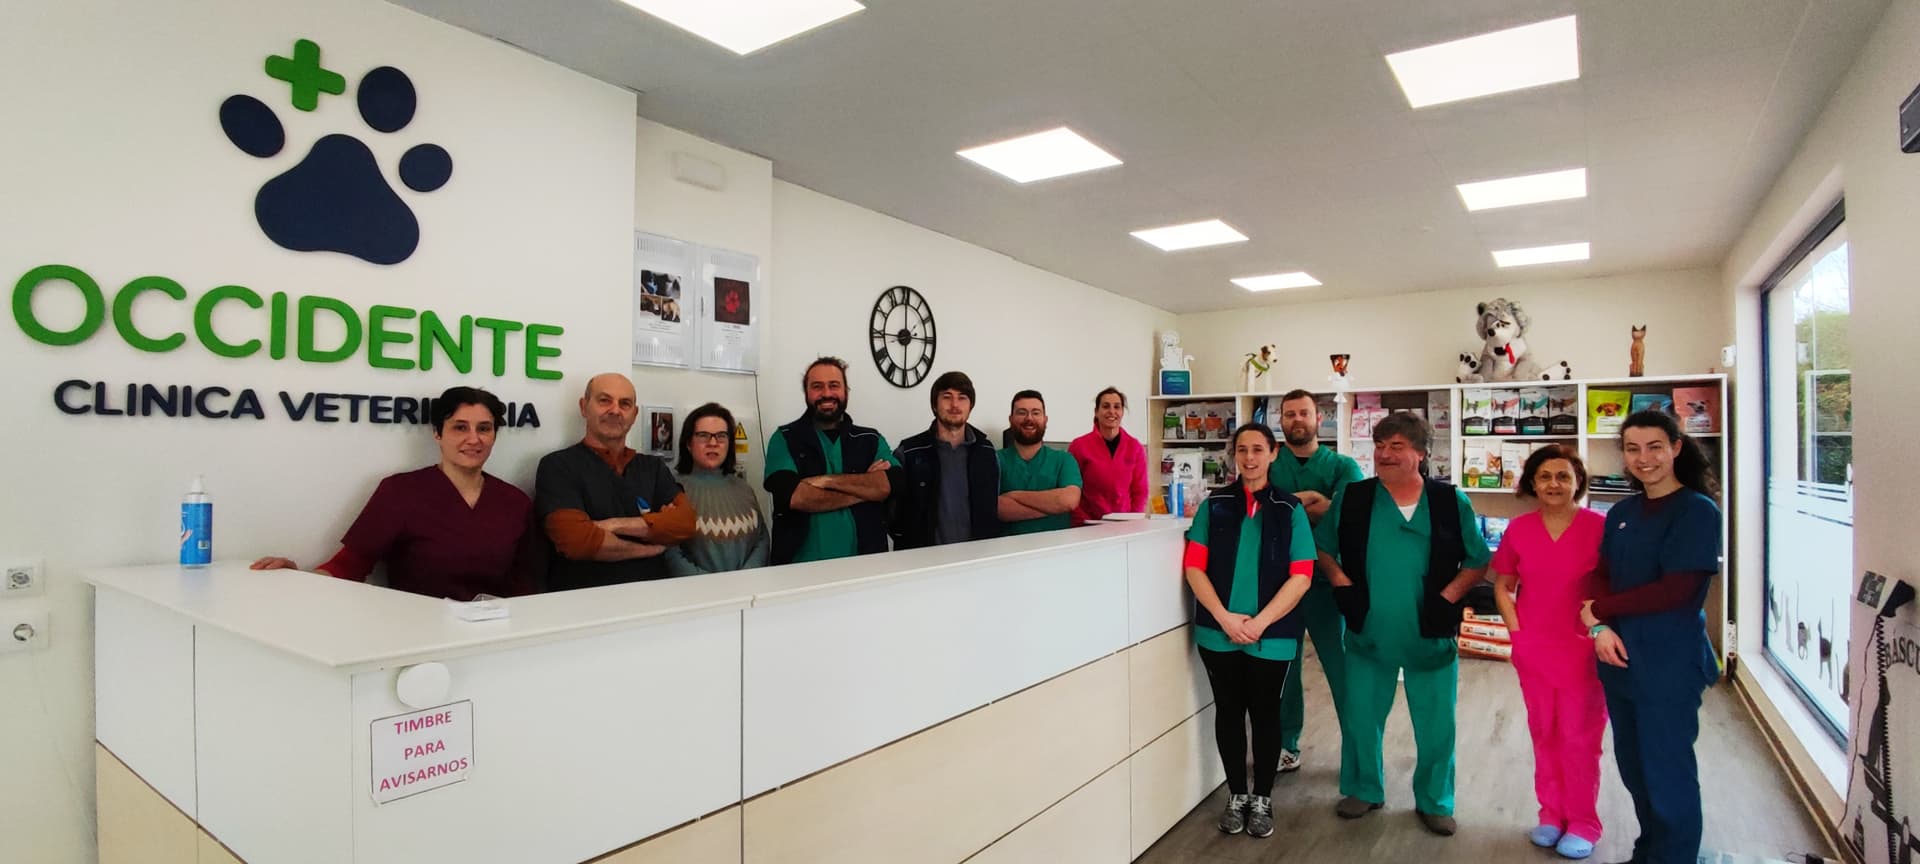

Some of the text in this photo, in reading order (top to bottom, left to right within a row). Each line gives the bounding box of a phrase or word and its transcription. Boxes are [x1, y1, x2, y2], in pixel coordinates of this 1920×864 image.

[12, 264, 564, 380] OCCIDENTE
[54, 379, 541, 429] CLINICA VETERIIA
[394, 711, 452, 735] TIMBRE
[404, 740, 445, 761] PARA
[379, 757, 468, 792] AVISARNOS
